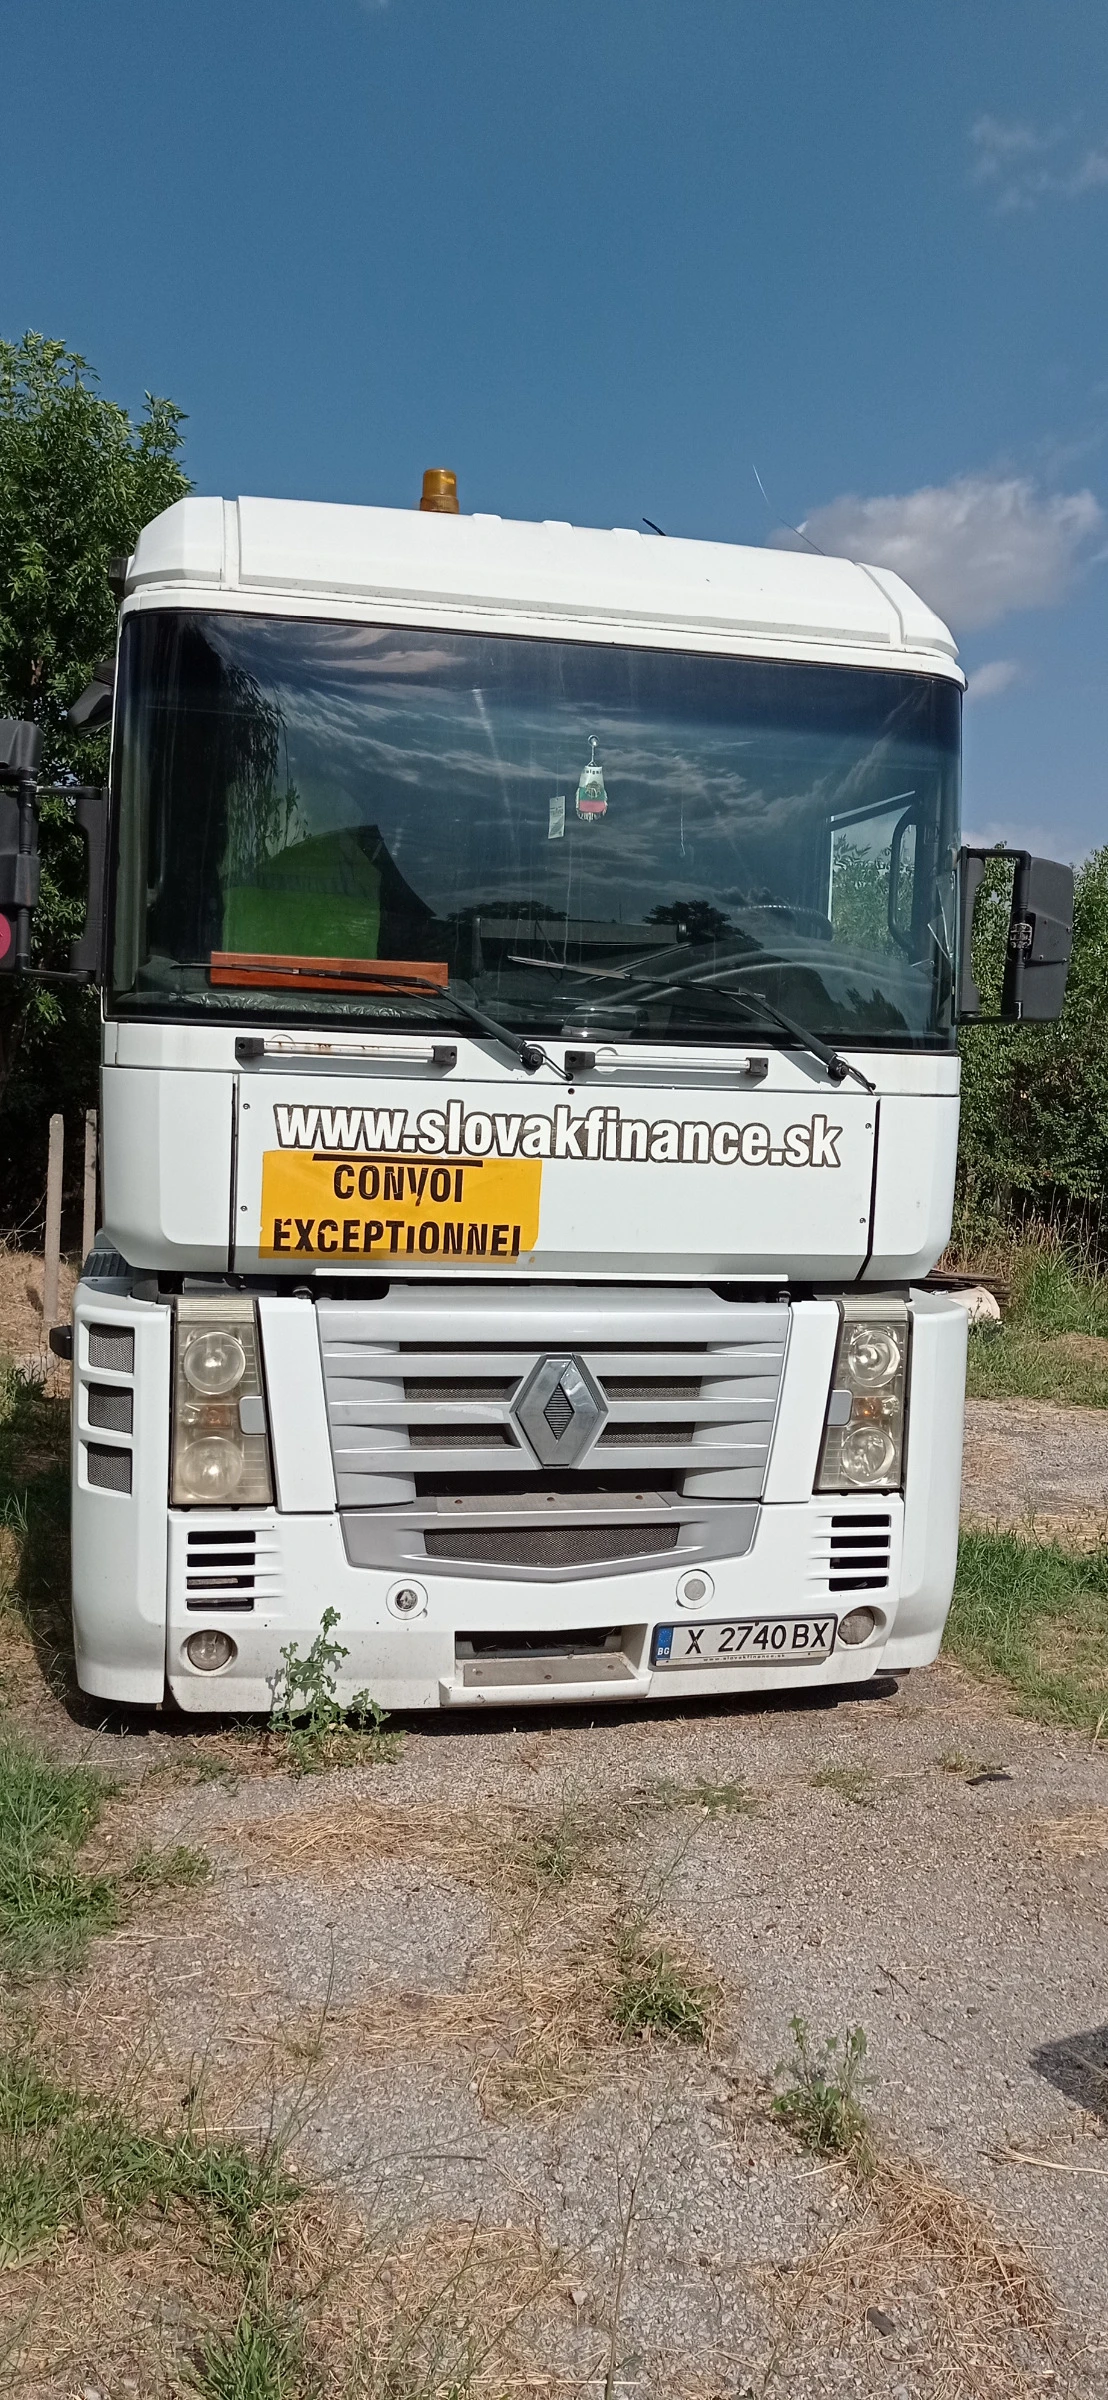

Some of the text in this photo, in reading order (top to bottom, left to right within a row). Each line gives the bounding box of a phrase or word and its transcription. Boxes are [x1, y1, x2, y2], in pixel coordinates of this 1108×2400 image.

[273, 1100, 843, 1168] www.slovakfinance.sk
[333, 1164, 463, 1207] CONVOI
[657, 1648, 670, 1656] BG
[718, 1624, 787, 1652] 2740
[792, 1622, 829, 1648] BX
